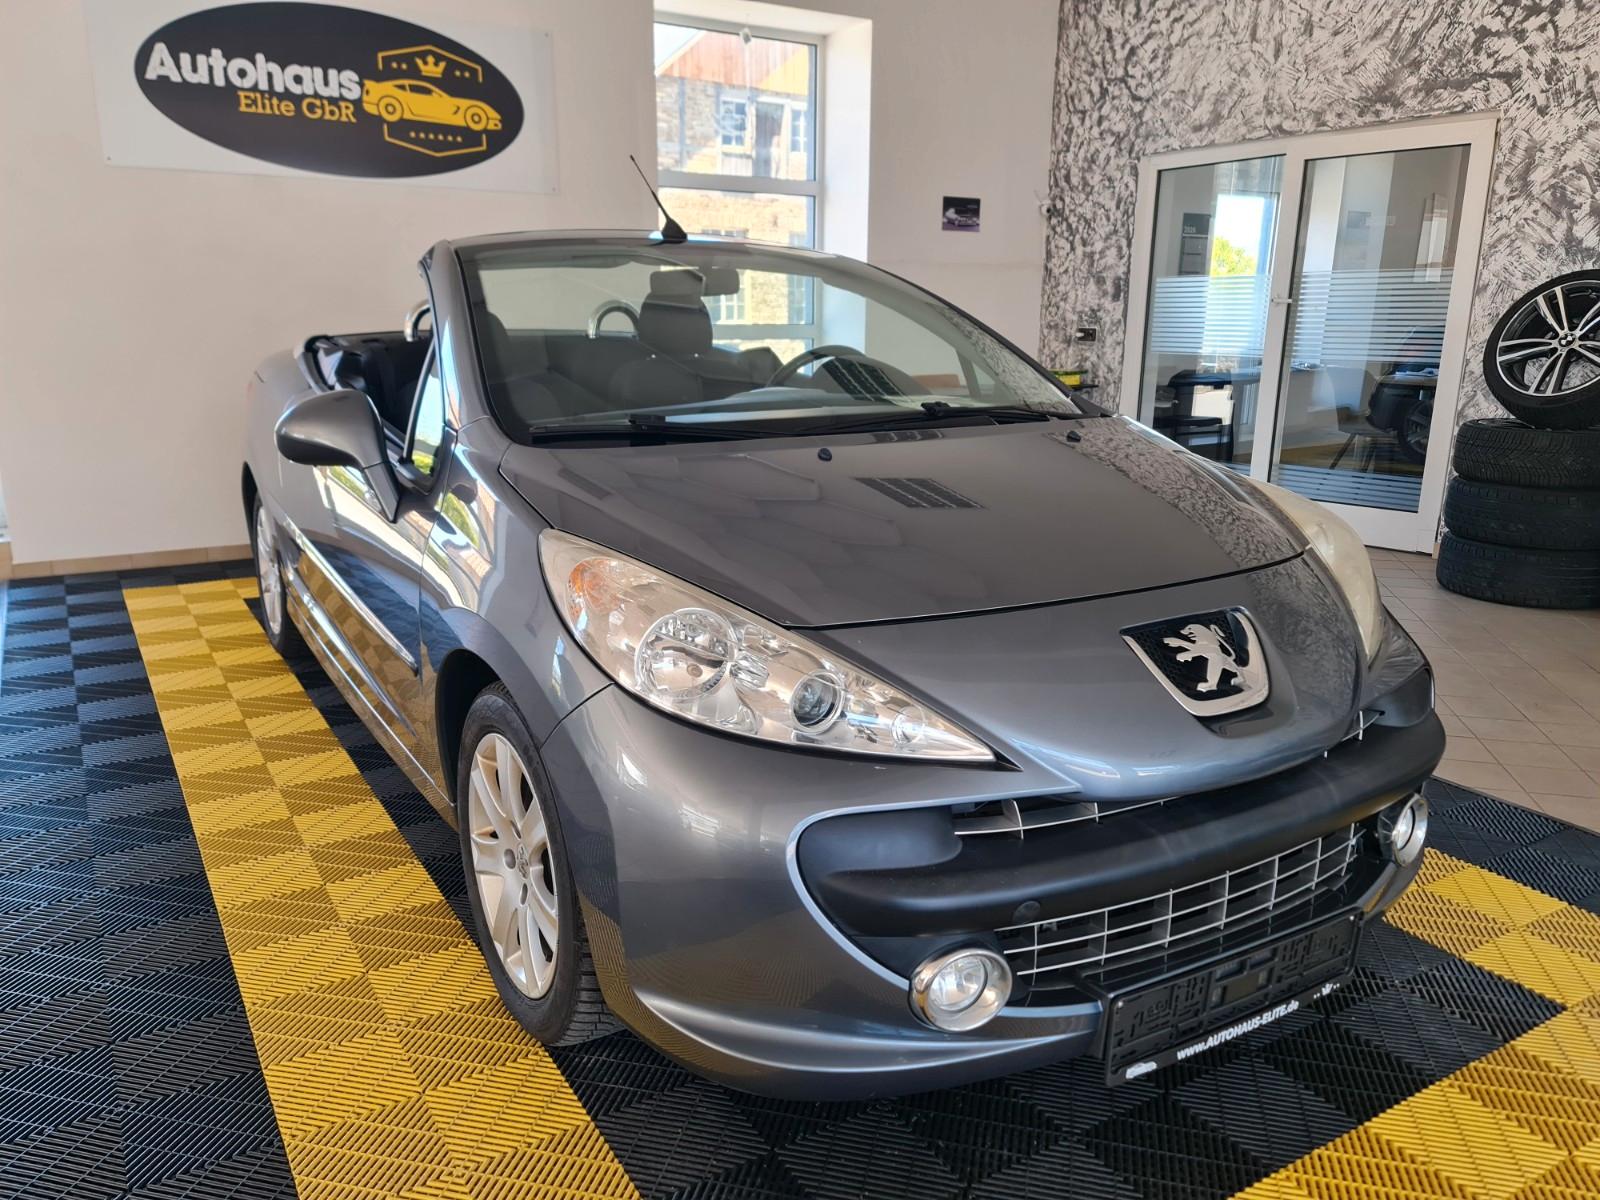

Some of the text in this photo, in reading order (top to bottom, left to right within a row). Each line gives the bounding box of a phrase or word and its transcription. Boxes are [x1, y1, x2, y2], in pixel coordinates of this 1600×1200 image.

[145, 42, 362, 99] Autohaus
[237, 91, 357, 122] Elite GbR
[1176, 1000, 1299, 1060] www.AUTOHAUS-ELITE.de
